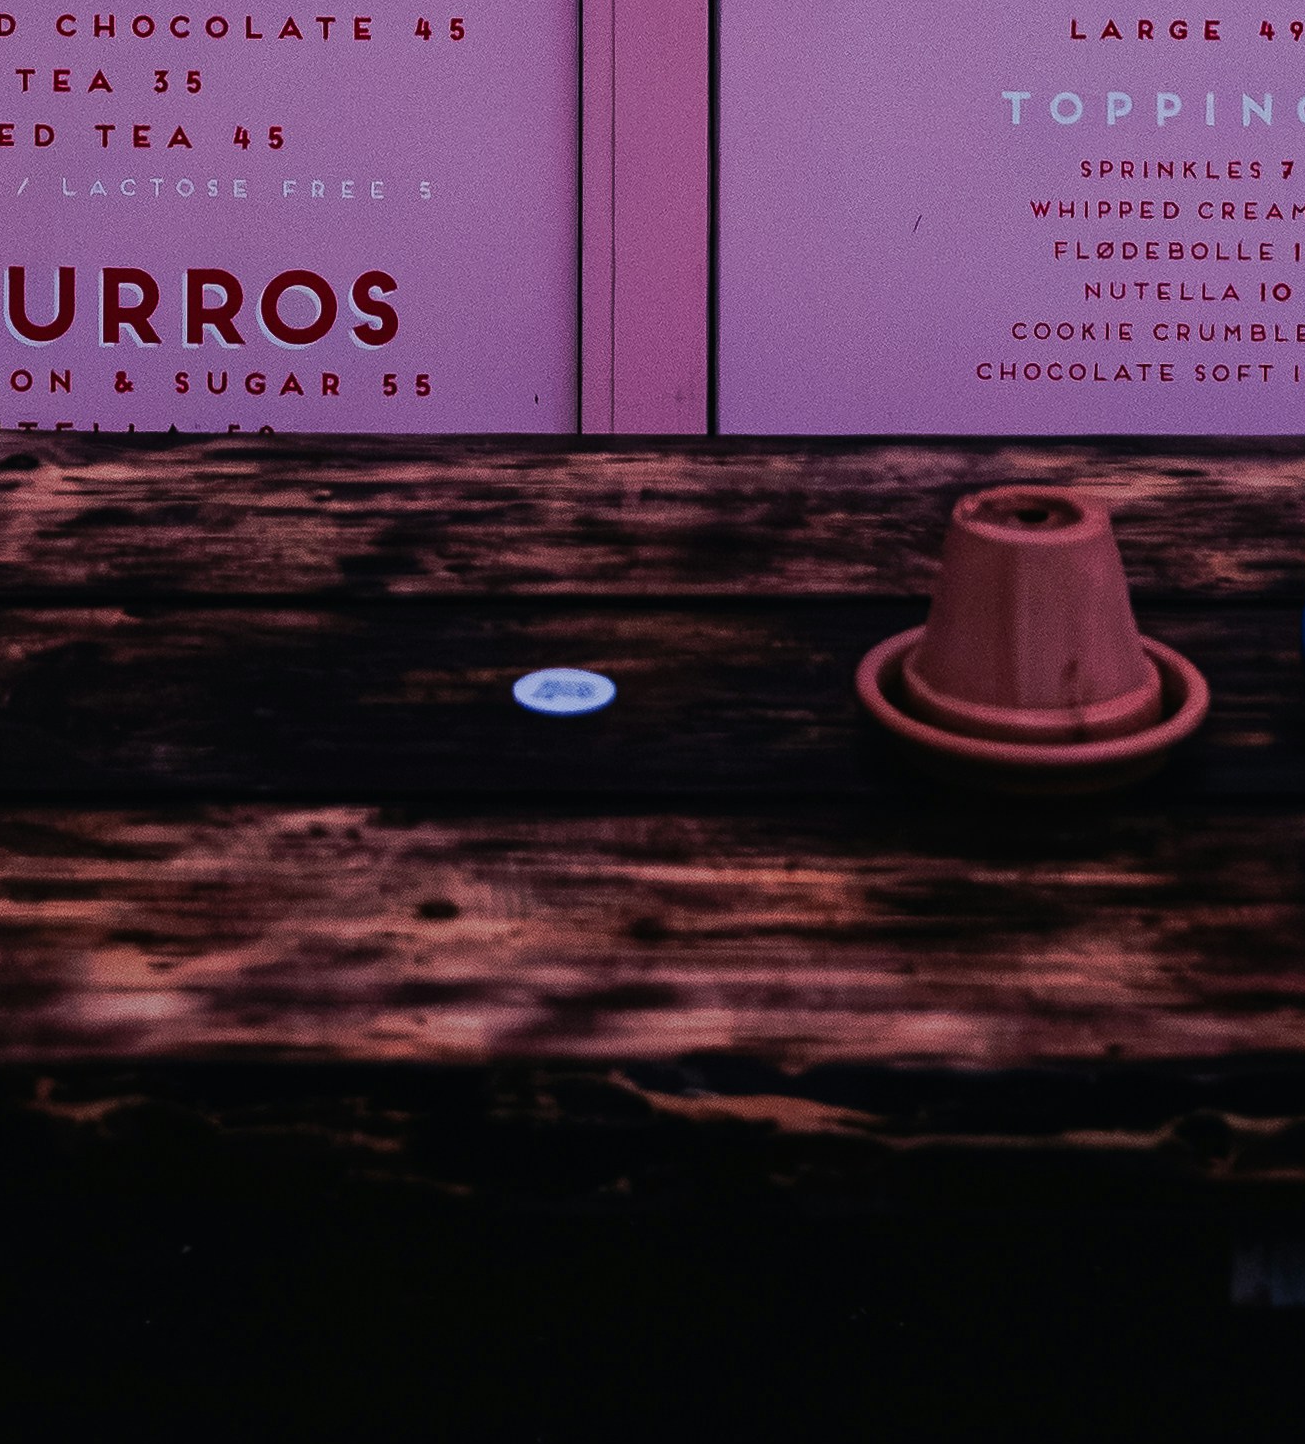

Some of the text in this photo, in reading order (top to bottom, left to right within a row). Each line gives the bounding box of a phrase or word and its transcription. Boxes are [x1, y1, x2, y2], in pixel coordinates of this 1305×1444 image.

[56, 13, 374, 42] CHOCOLATE
[414, 17, 467, 42] 45
[1070, 19, 1305, 43] LARGE 49
[15, 68, 204, 95] TEA 35
[95, 124, 195, 151] TEA
[233, 126, 286, 150] 45
[1080, 160, 1294, 181] SPRINKLES 7
[61, 177, 249, 198] LACTOSE
[282, 179, 385, 200] FREE
[1030, 200, 1181, 221] WHIPPED
[1053, 241, 1275, 263] FLØDEBOLLE
[1084, 282, 1292, 303] NUTELLA 10
[1011, 322, 1134, 344] COOKIE
[114, 370, 135, 394] &
[175, 370, 342, 397] SUGAR
[383, 373, 433, 398] 55
[975, 363, 1175, 384] CHOCOLATE
[1194, 363, 1272, 384] SOFT
